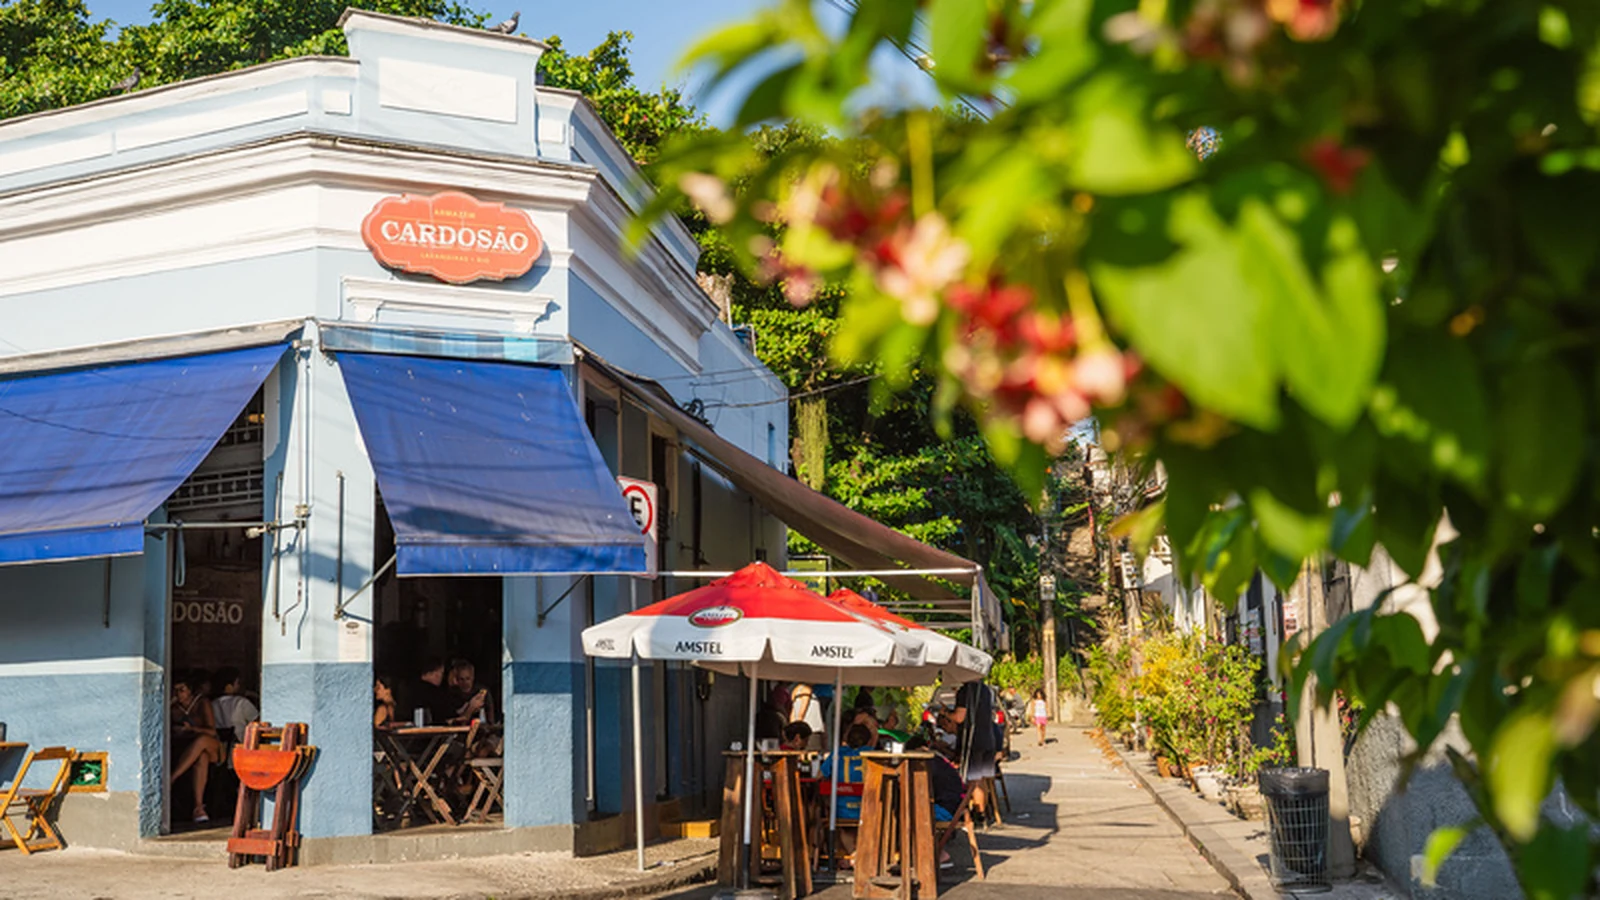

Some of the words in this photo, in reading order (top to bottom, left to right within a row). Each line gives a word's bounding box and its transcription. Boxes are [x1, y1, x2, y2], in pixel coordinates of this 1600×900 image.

[381, 220, 529, 252] CARDOSÃO
[675, 641, 723, 654] AMSTEL
[811, 645, 854, 659] AMSTEL
